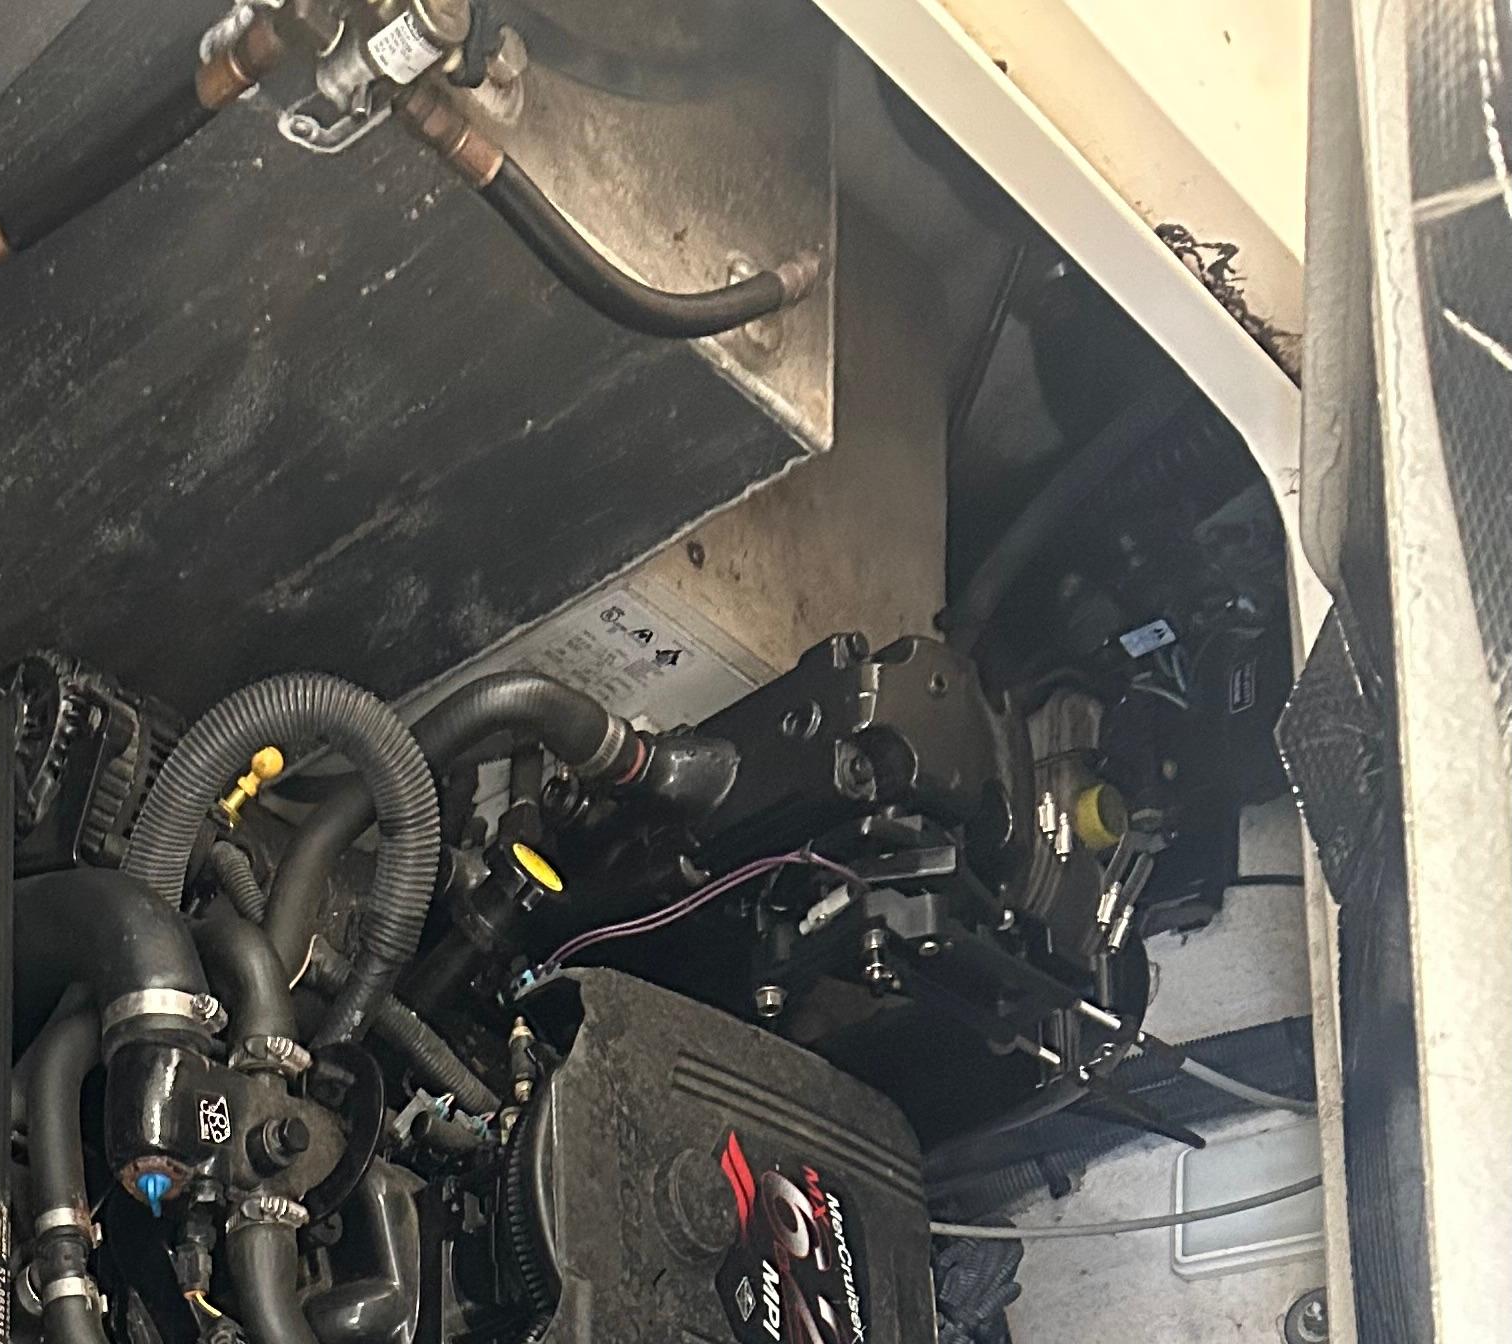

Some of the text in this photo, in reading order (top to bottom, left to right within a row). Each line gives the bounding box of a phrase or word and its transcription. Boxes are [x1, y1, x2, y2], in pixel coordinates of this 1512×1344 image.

[802, 1164, 826, 1217] MX
[762, 1259, 780, 1341] MPI
[826, 1192, 864, 1343] MerCruiser
